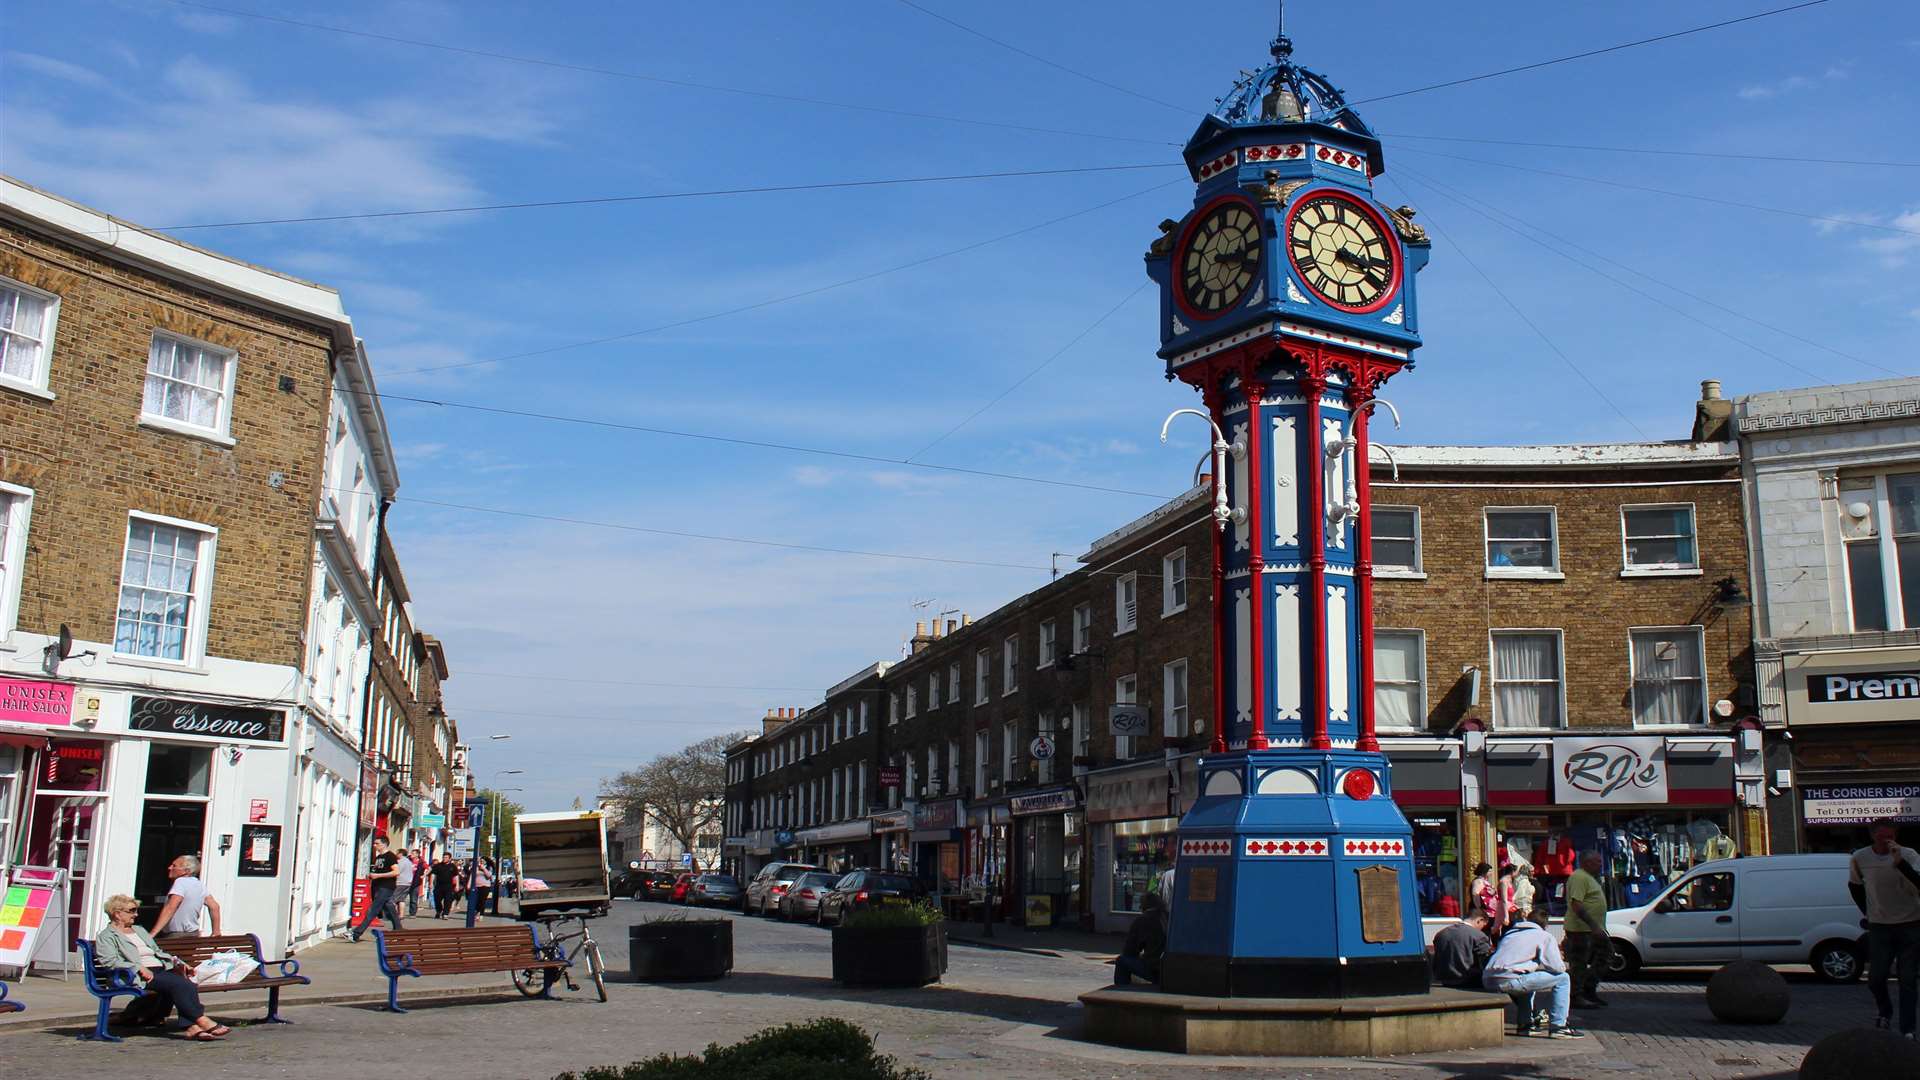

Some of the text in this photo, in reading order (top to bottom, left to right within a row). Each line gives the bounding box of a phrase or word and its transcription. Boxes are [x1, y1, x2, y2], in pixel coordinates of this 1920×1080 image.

[7, 685, 67, 701] UNISEX
[2, 698, 68, 716] HAIR SALON
[174, 703, 199, 716] club
[172, 713, 266, 736] essence
[1568, 752, 1659, 798] RJ's
[1806, 786, 1920, 799] THE CORNER SHOP
[1816, 806, 1912, 816] Tel: 01795 666419
